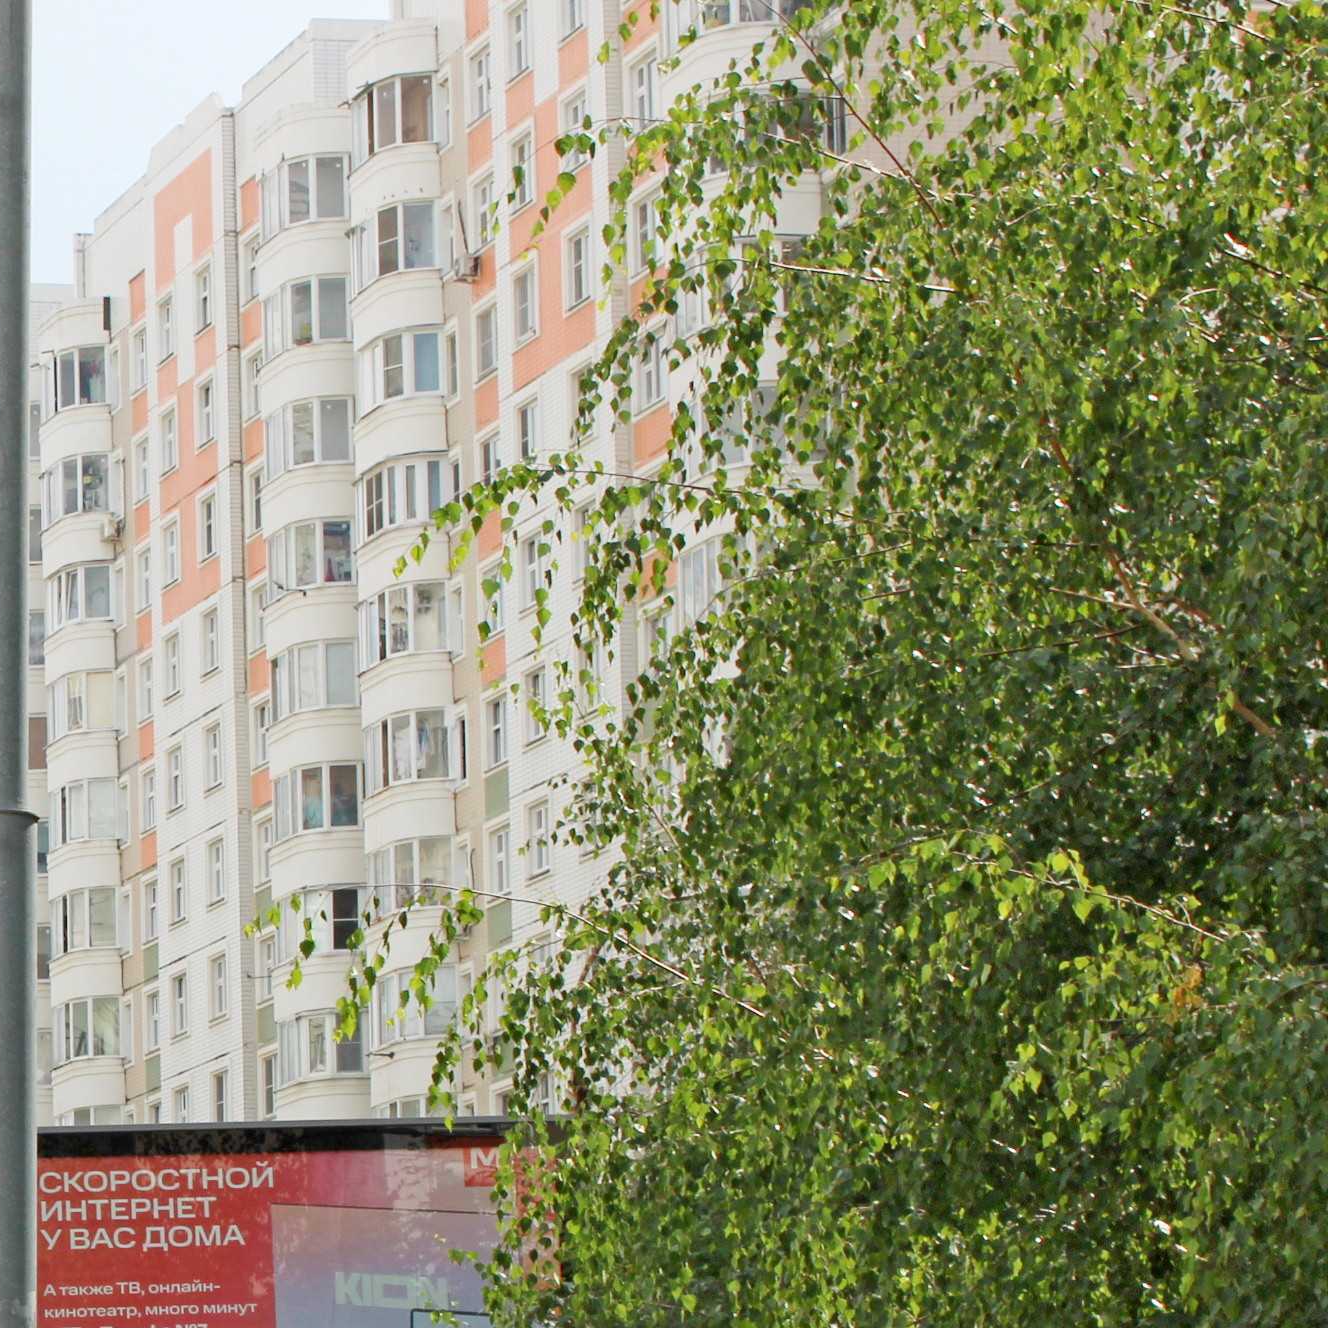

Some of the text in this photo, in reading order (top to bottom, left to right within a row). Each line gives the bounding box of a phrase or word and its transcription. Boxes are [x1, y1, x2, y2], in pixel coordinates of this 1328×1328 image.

[39, 1160, 275, 1194] СКОРОСТНОЙ
[40, 1197, 217, 1222] ИНТЕРНЕТ
[40, 1224, 246, 1252] У ВАС ДОМА
[44, 1279, 222, 1297] А также ТВ, онлайн-
[44, 1302, 257, 1320] кинотеатр, много минут
